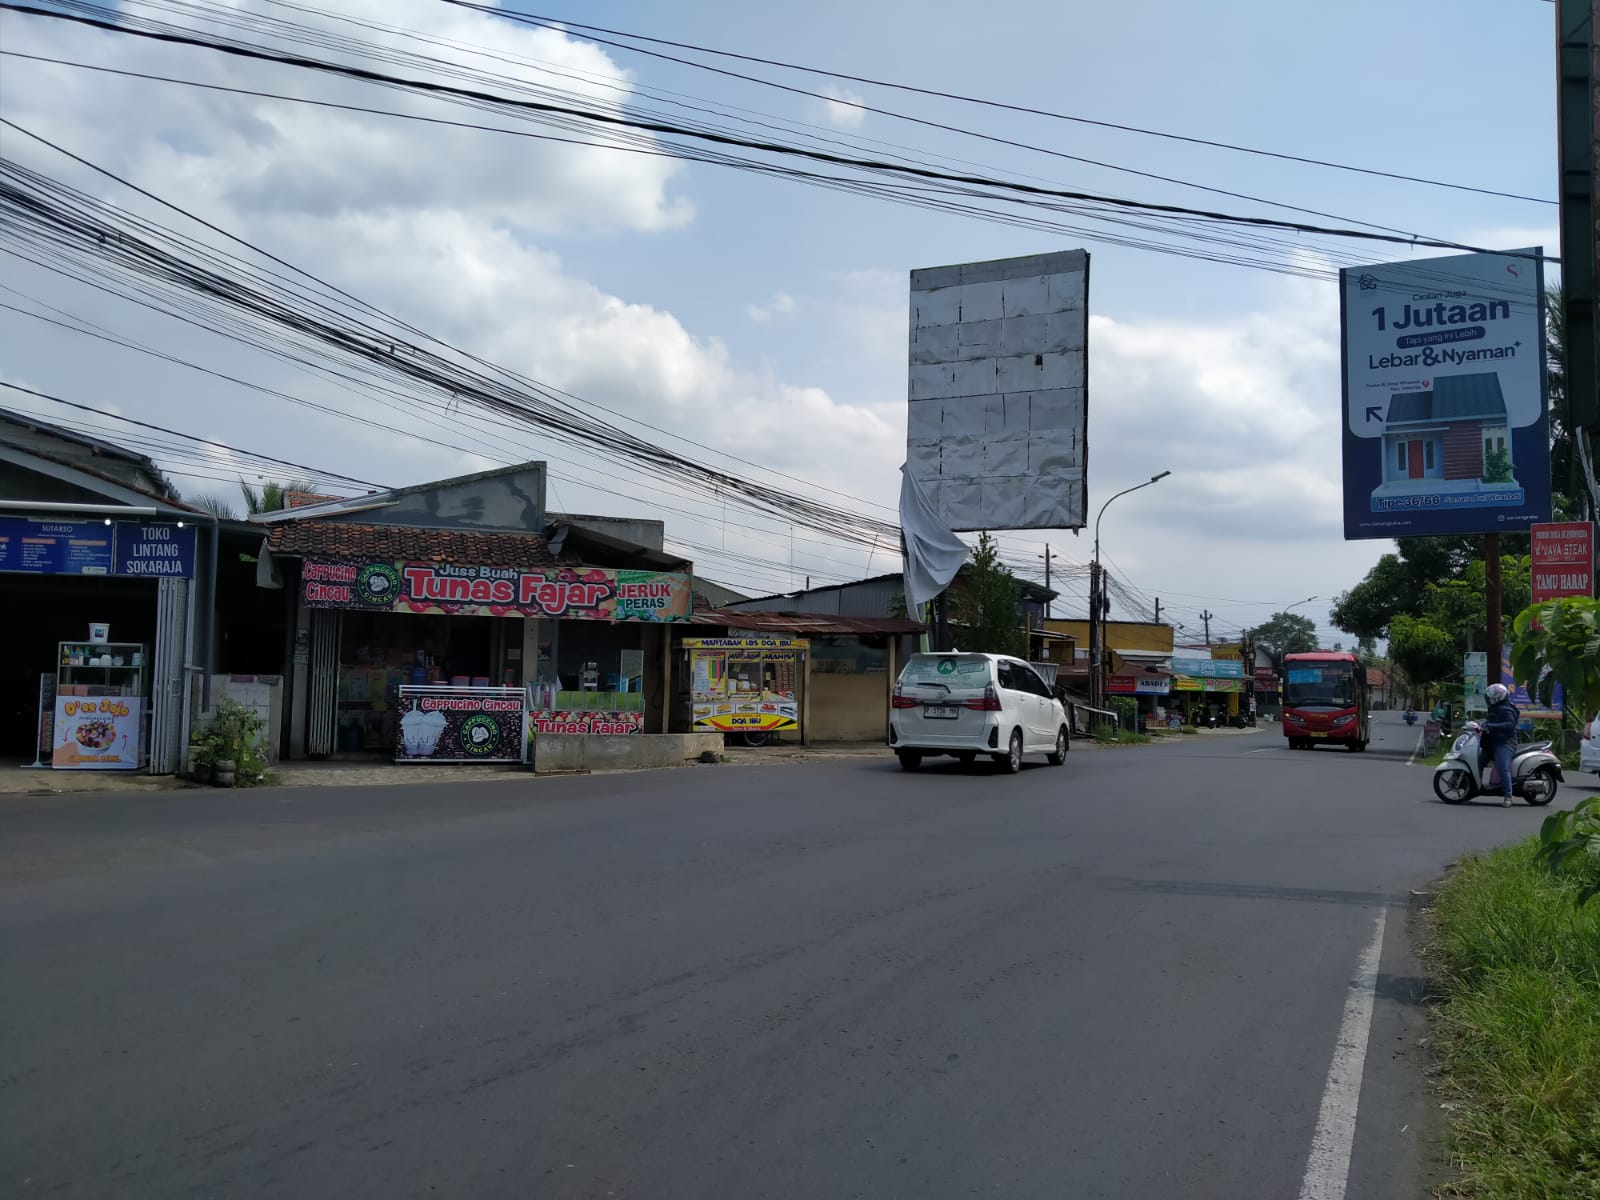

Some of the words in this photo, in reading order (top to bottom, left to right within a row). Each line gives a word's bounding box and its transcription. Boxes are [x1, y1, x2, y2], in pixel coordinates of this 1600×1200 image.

[1412, 292, 1442, 302] Cicilan
[1444, 290, 1467, 299] Juga
[1371, 306, 1386, 331] 1
[1392, 300, 1510, 330] Jutaan
[1406, 336, 1421, 346] Tapi
[1423, 334, 1442, 344] yang
[1445, 331, 1454, 339] ini
[1455, 329, 1477, 338] Lebih
[1376, 497, 1402, 510] Tipe
[141, 527, 170, 540] TOKO
[133, 543, 179, 557] LINTANG
[1564, 543, 1587, 555] STEAK
[126, 560, 183, 574] SOKARAJA
[304, 561, 357, 582] Cappucino
[439, 564, 477, 578] Juss
[479, 566, 518, 579] Buah
[1536, 574, 1558, 589] TAMU
[1561, 574, 1588, 589] HARAP
[306, 581, 350, 602] Cincau
[404, 567, 515, 602] Tunas
[519, 572, 611, 614] Fajar
[618, 583, 672, 599] JERUK
[625, 598, 665, 609] PERAS
[422, 698, 481, 710] Cappucino
[482, 699, 521, 711] Cincau
[535, 718, 588, 735] Tunas
[590, 718, 637, 735] Fajar
[466, 743, 493, 753] CINCAU
